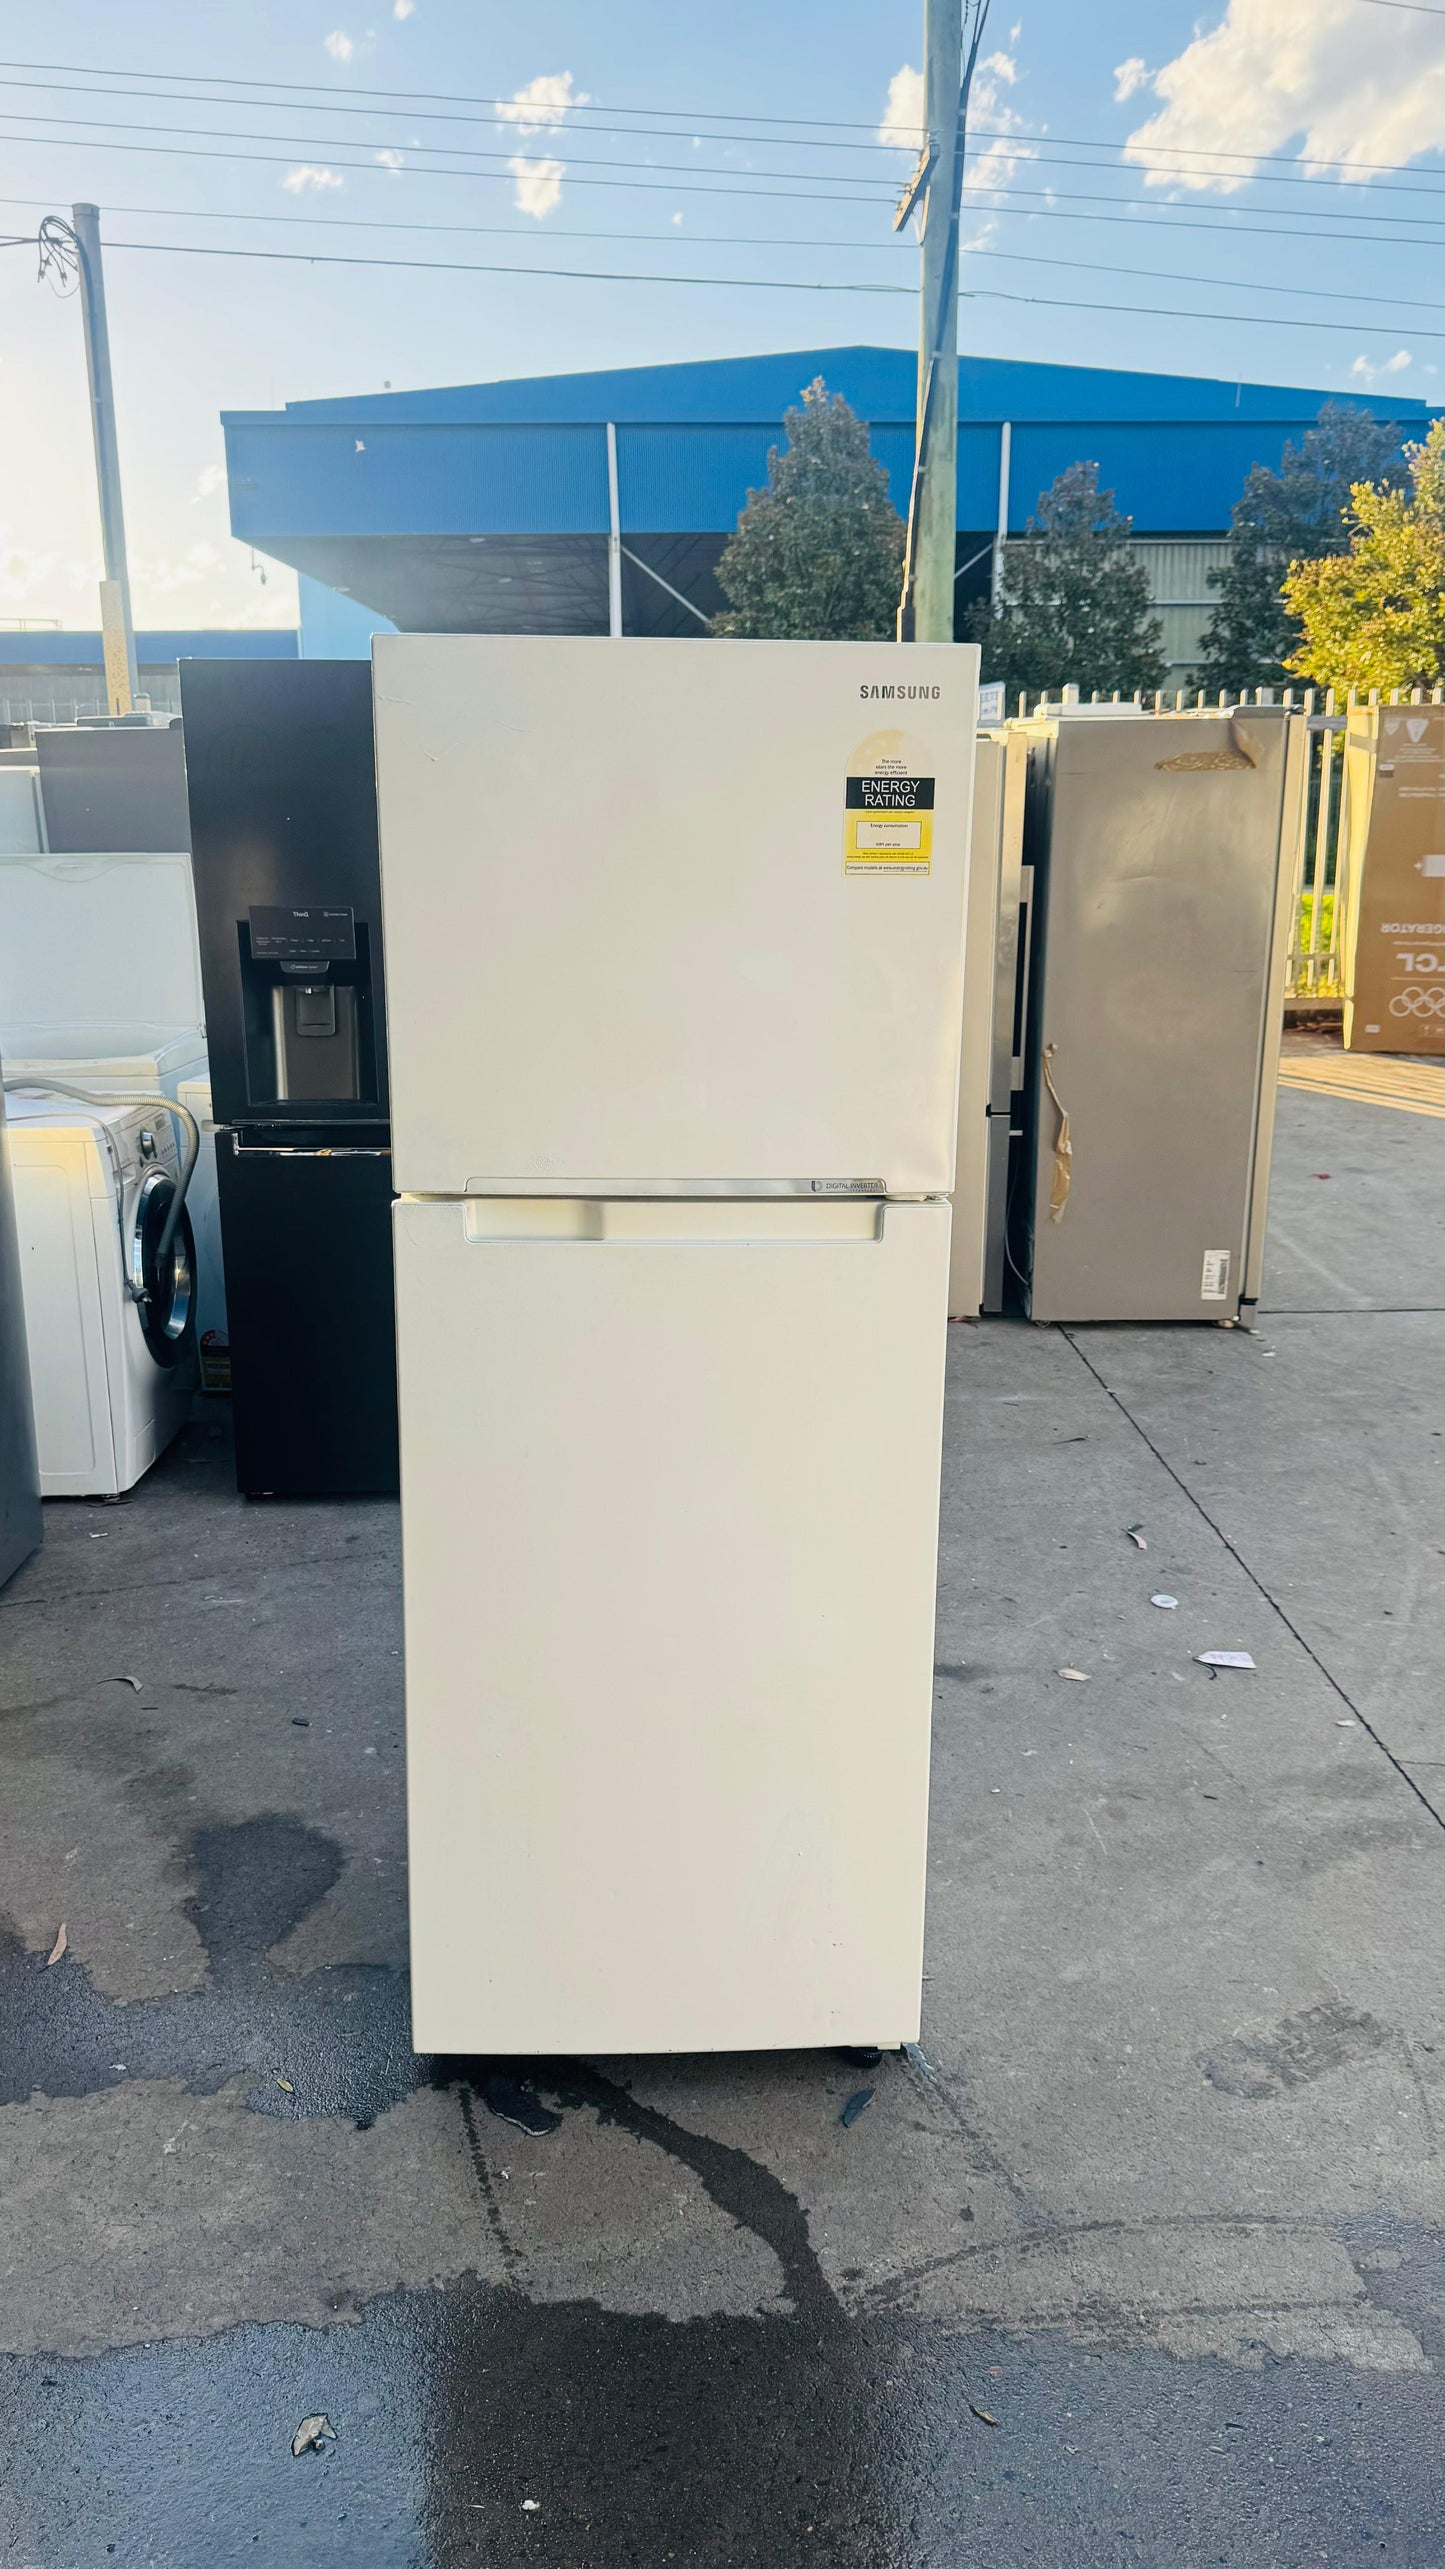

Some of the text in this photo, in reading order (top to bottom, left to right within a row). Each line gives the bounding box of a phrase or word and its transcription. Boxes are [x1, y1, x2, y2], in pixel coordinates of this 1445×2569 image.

[860, 685, 941, 700] SAMSUNG
[861, 780, 921, 793] ENERGY
[864, 794, 916, 807] RATING
